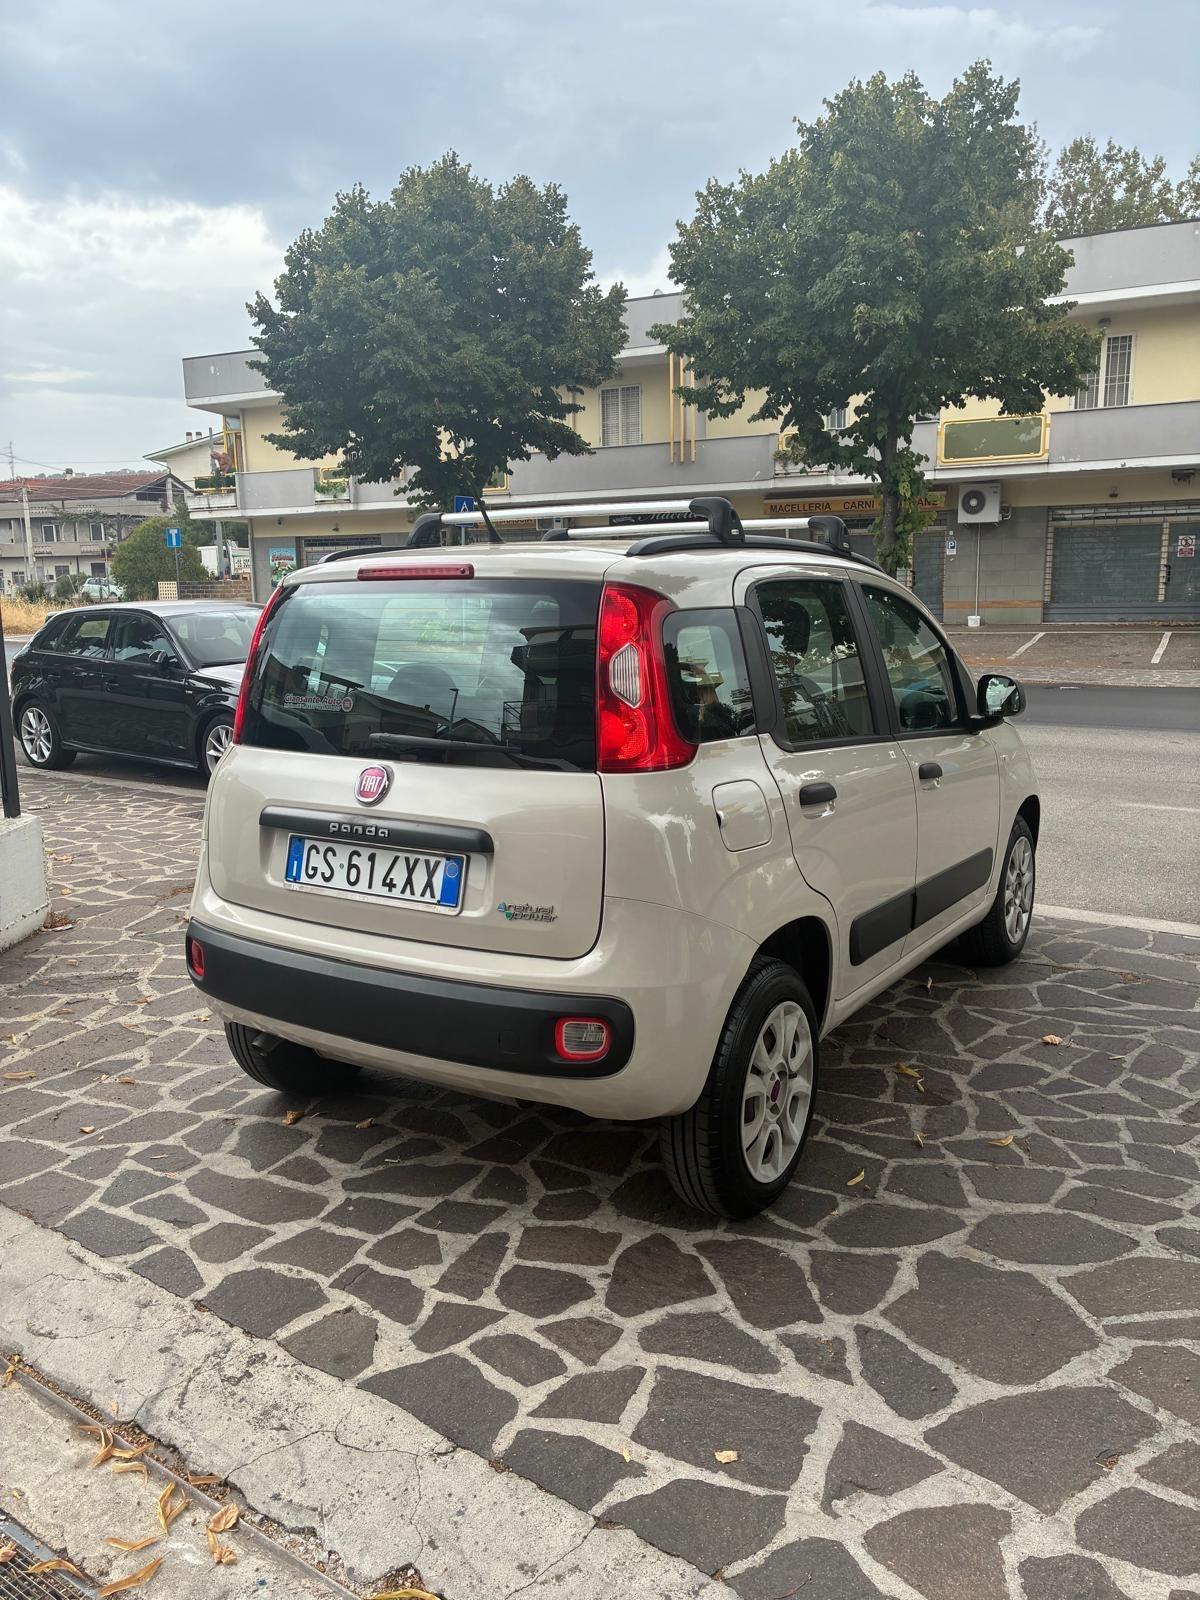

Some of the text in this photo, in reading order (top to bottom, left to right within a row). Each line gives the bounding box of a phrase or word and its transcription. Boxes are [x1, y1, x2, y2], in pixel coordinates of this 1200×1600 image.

[770, 500, 875, 513] MACELLERIA CARNI
[322, 696, 342, 706] Auto
[361, 775, 382, 792] FIAT
